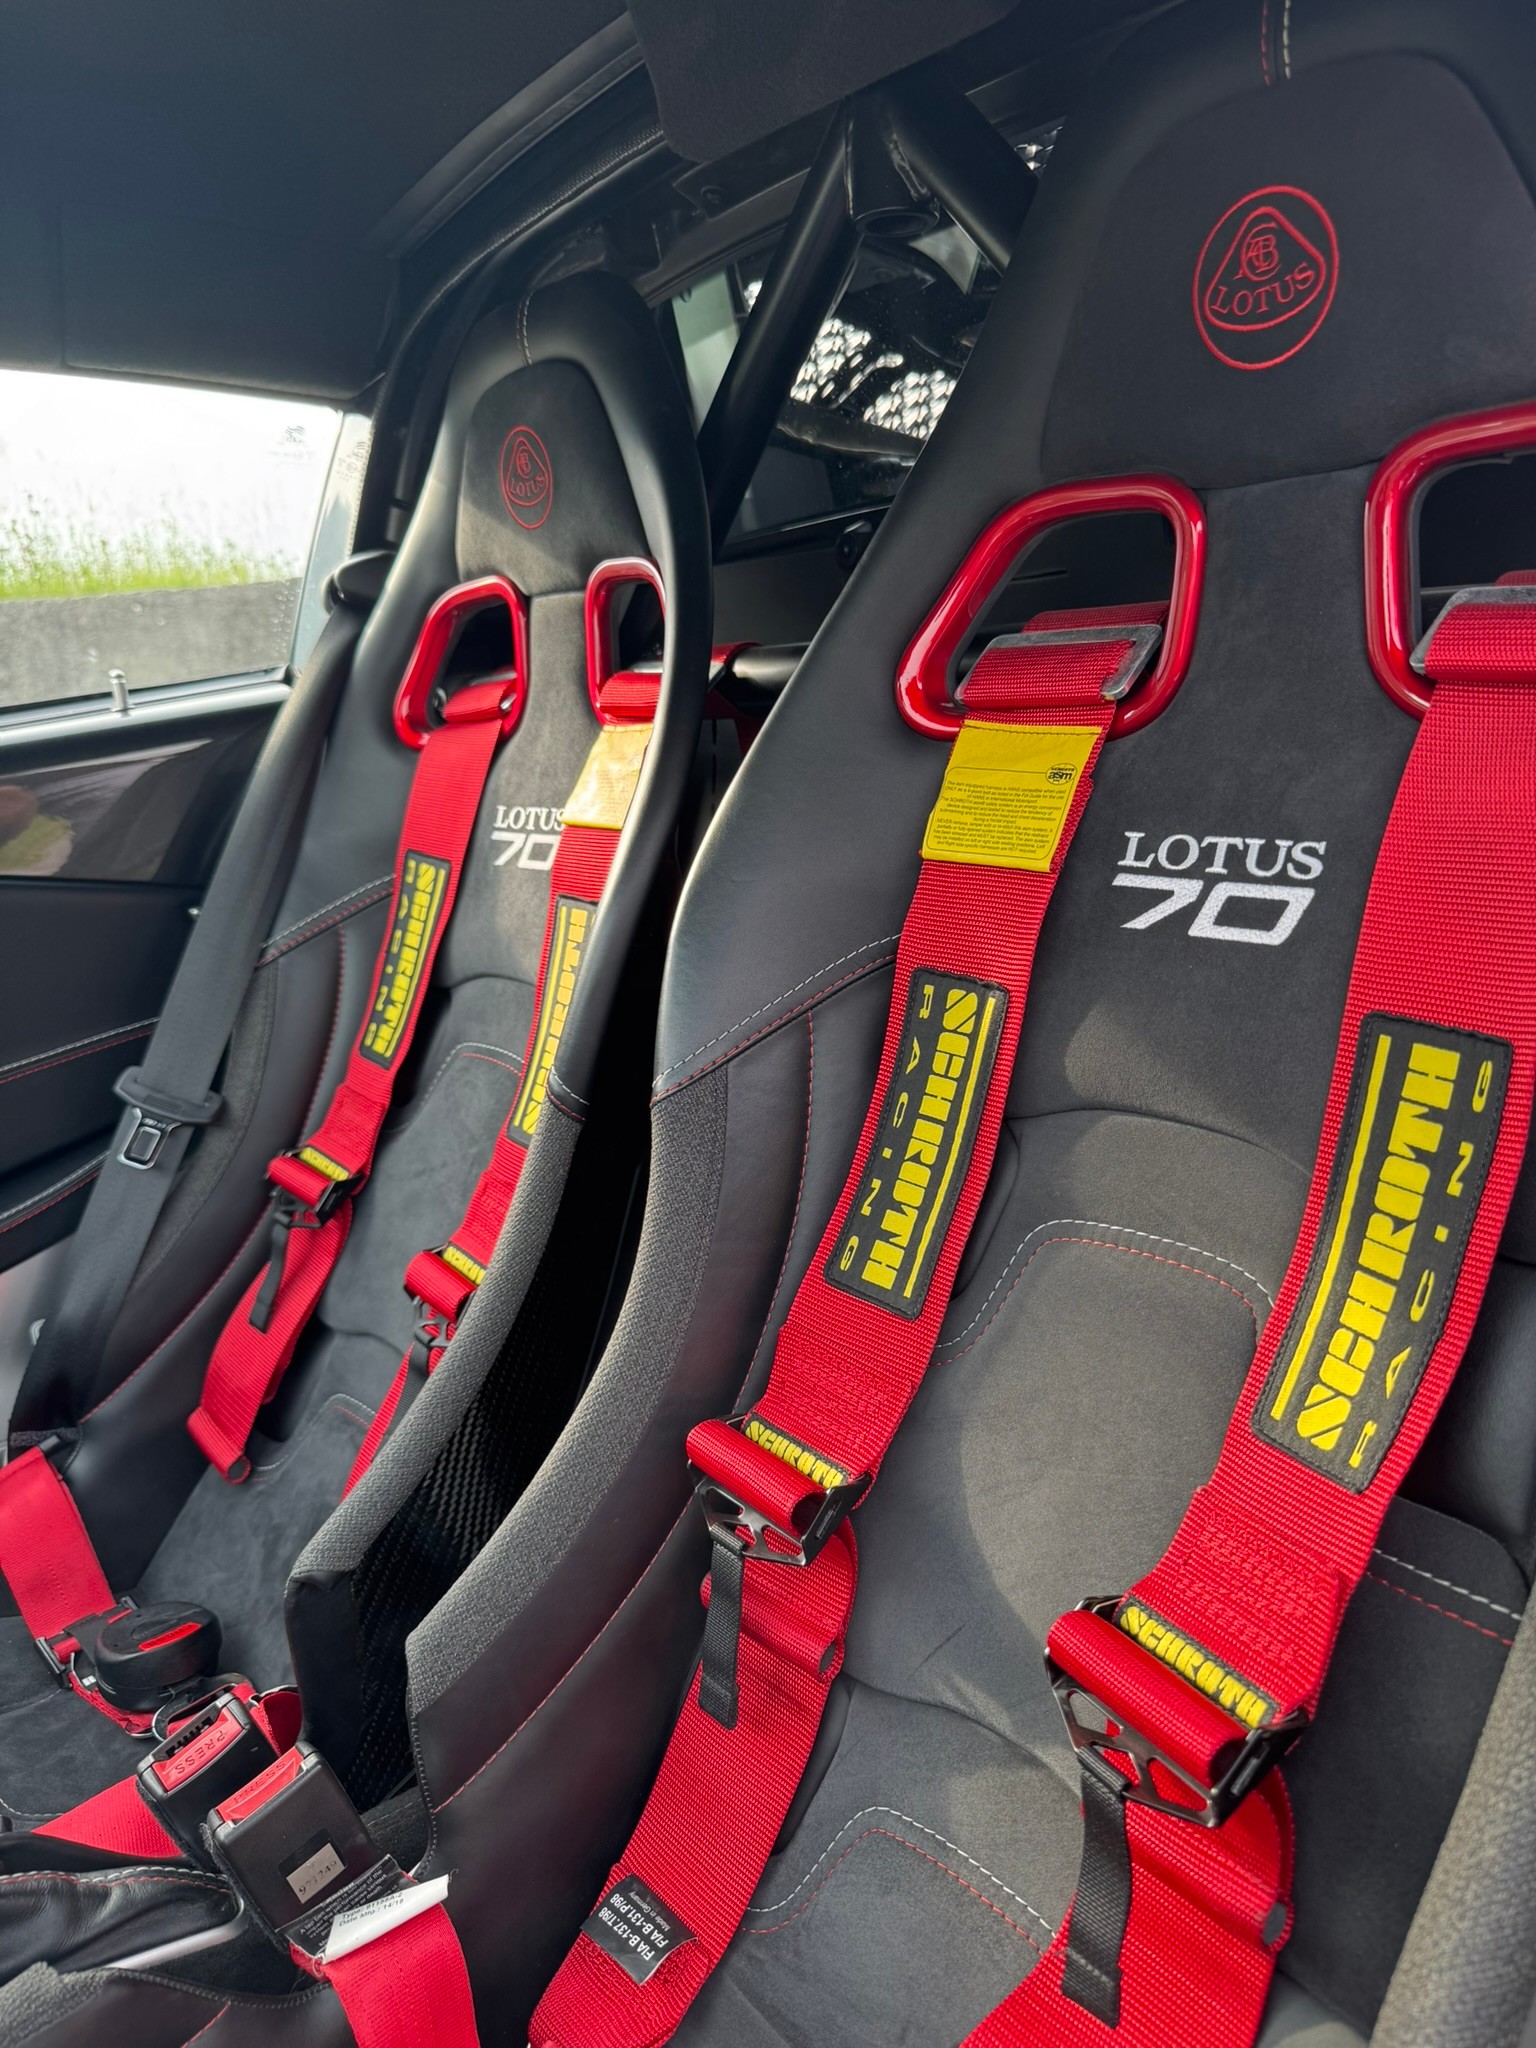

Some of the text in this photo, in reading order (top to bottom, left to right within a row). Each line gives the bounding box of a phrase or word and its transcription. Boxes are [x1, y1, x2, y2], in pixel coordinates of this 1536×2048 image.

[1210, 262, 1315, 316] LOTUS
[509, 473, 545, 497] LOTUS
[1048, 771, 1073, 780] asm
[493, 805, 566, 831] LOTUS
[490, 831, 562, 871] 70
[1117, 831, 1327, 880] LOTUS
[1111, 872, 1315, 946] 70
[372, 862, 436, 1055] SCHROTH
[861, 988, 978, 1291] SCHROTH
[1296, 1043, 1461, 1452] SCHROTH
[745, 1420, 843, 1489] SCHROTH
[1119, 1606, 1268, 1729] SCHROTH
[174, 1730, 226, 1775] PRESS
[233, 1762, 286, 1804] PRESS
[339, 1916, 358, 1927] Date
[598, 1906, 655, 1961] FIA B-137.T/98
[610, 1893, 669, 1948] FIA B-131.P/98
[628, 1890, 671, 1932] Made in Germany
